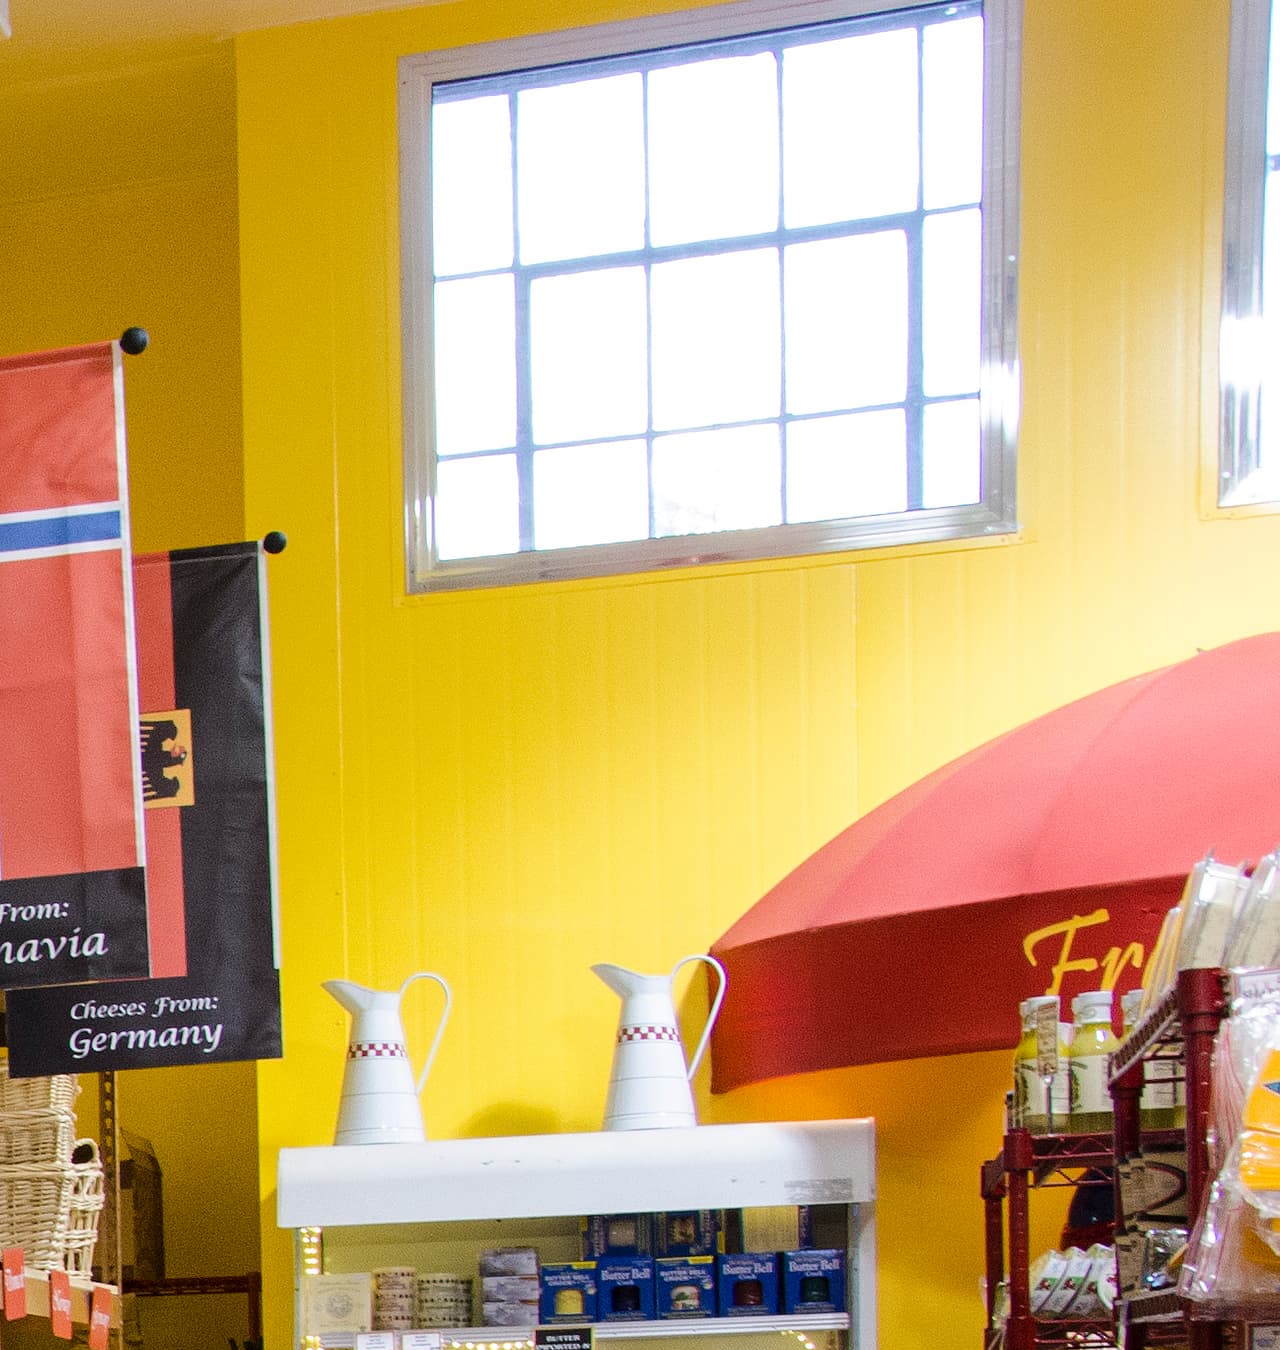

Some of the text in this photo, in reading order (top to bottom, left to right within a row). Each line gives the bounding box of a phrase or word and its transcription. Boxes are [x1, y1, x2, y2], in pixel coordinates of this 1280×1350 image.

[69, 993, 220, 1021] Cheeses From:
[68, 1020, 223, 1059] Germany
[722, 1261, 773, 1275] Butter Bell
[789, 1257, 841, 1272] Butter Bell
[601, 1267, 651, 1281] Butter Bell
[544, 1333, 581, 1343] BUTTER
